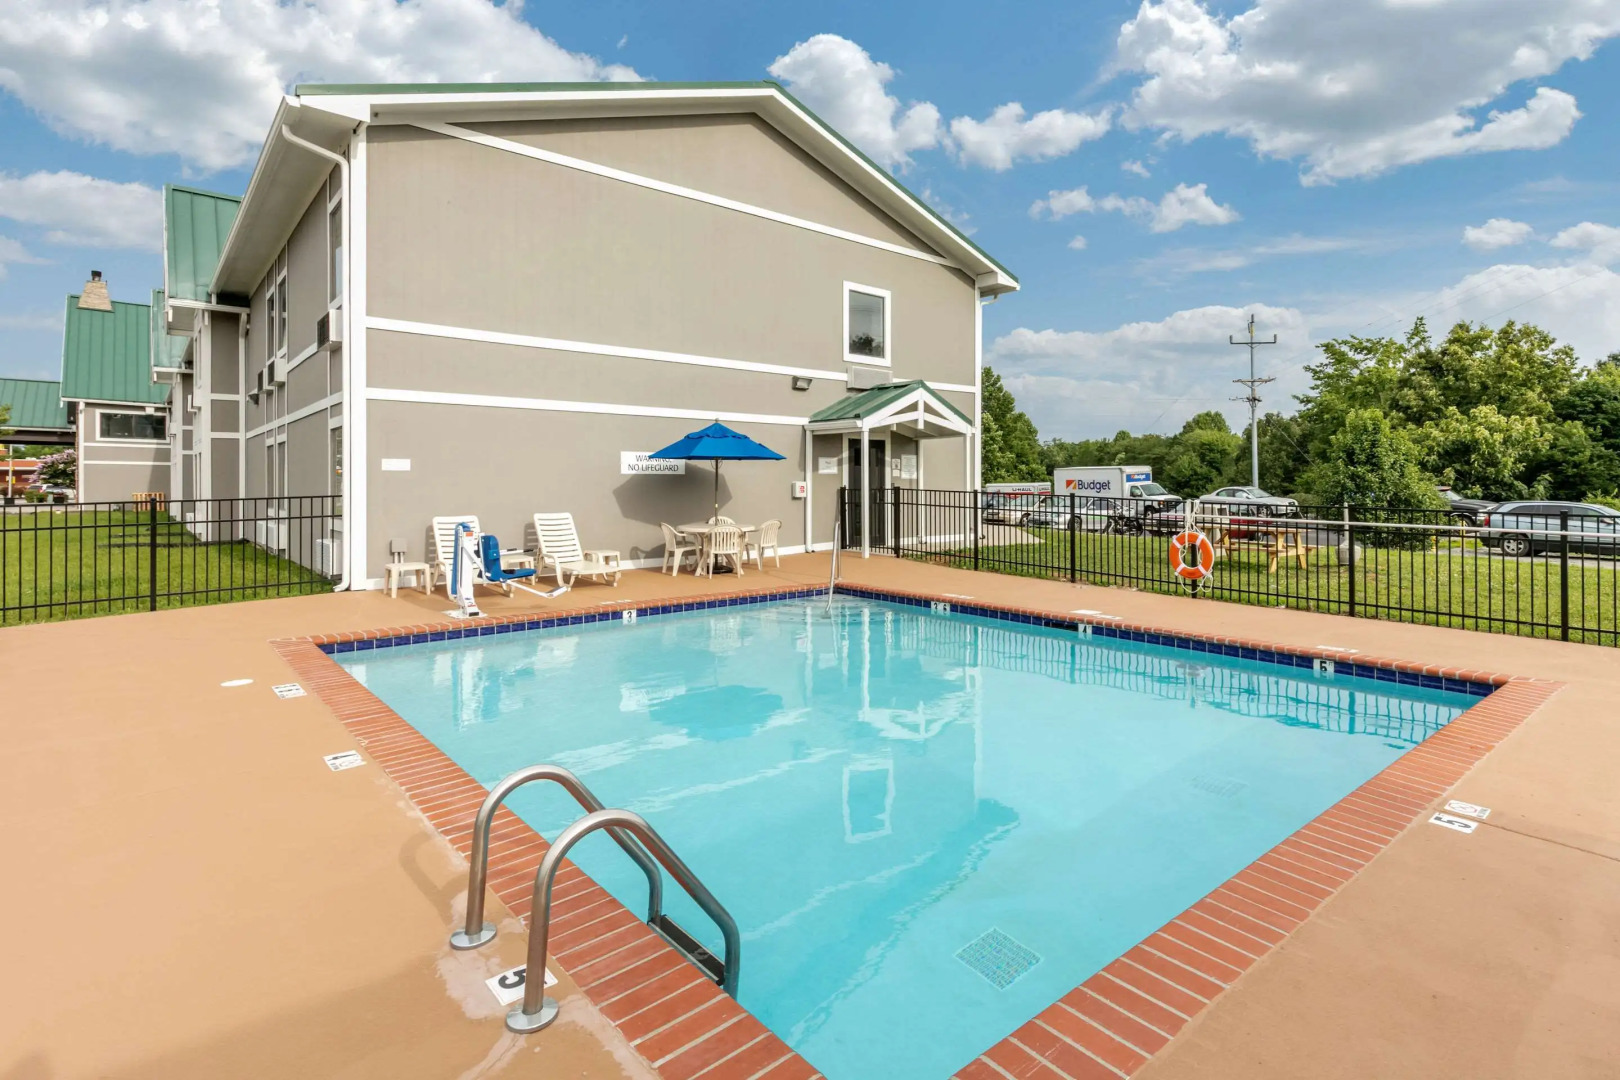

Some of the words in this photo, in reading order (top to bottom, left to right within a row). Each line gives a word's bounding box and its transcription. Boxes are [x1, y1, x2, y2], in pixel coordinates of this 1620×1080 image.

[628, 463, 640, 471] NO
[641, 464, 679, 472] LIFEGUARD
[1077, 479, 1111, 493] Budget
